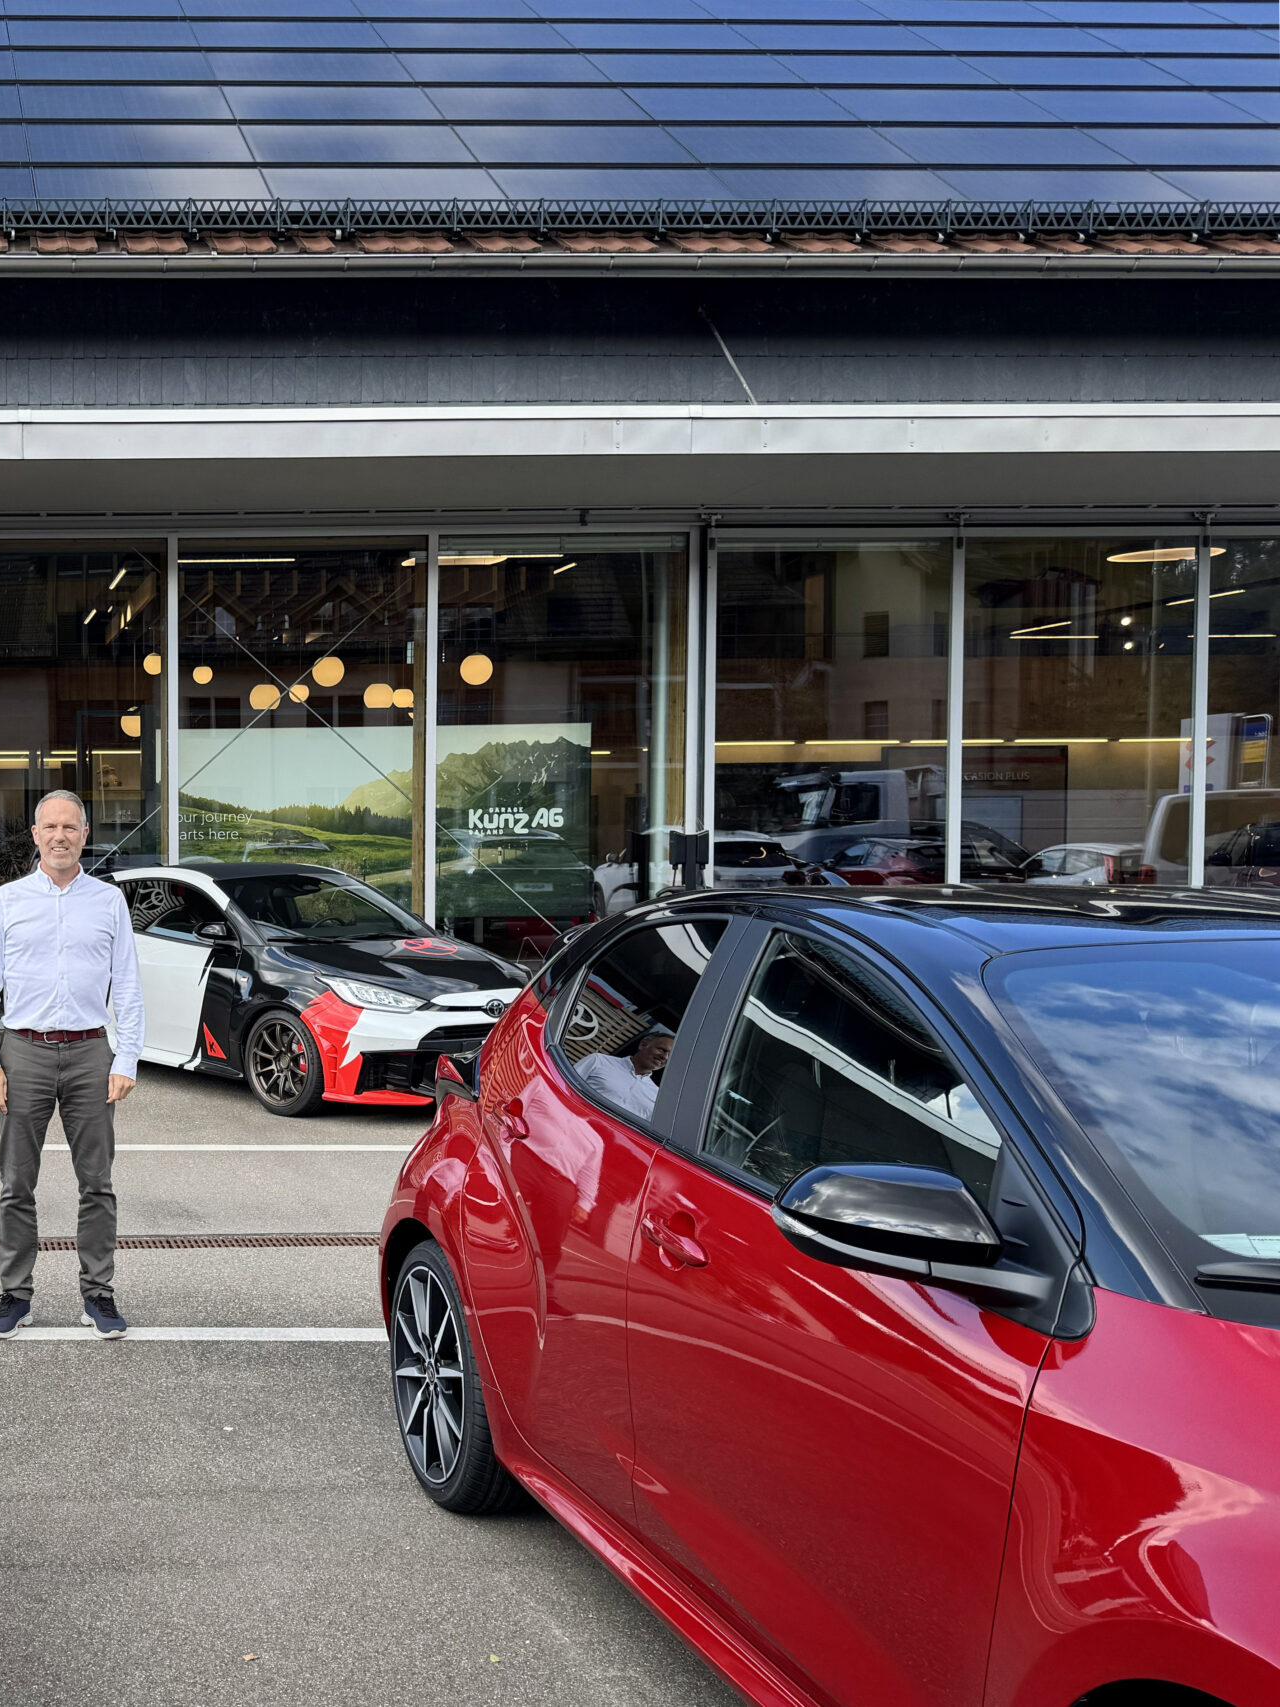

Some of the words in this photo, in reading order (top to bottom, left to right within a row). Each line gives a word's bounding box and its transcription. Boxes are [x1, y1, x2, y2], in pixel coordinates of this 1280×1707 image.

[179, 813, 197, 823] our
[201, 811, 252, 825] journey
[531, 807, 565, 828] AG
[179, 829, 205, 840] arts
[208, 828, 243, 840] here.
